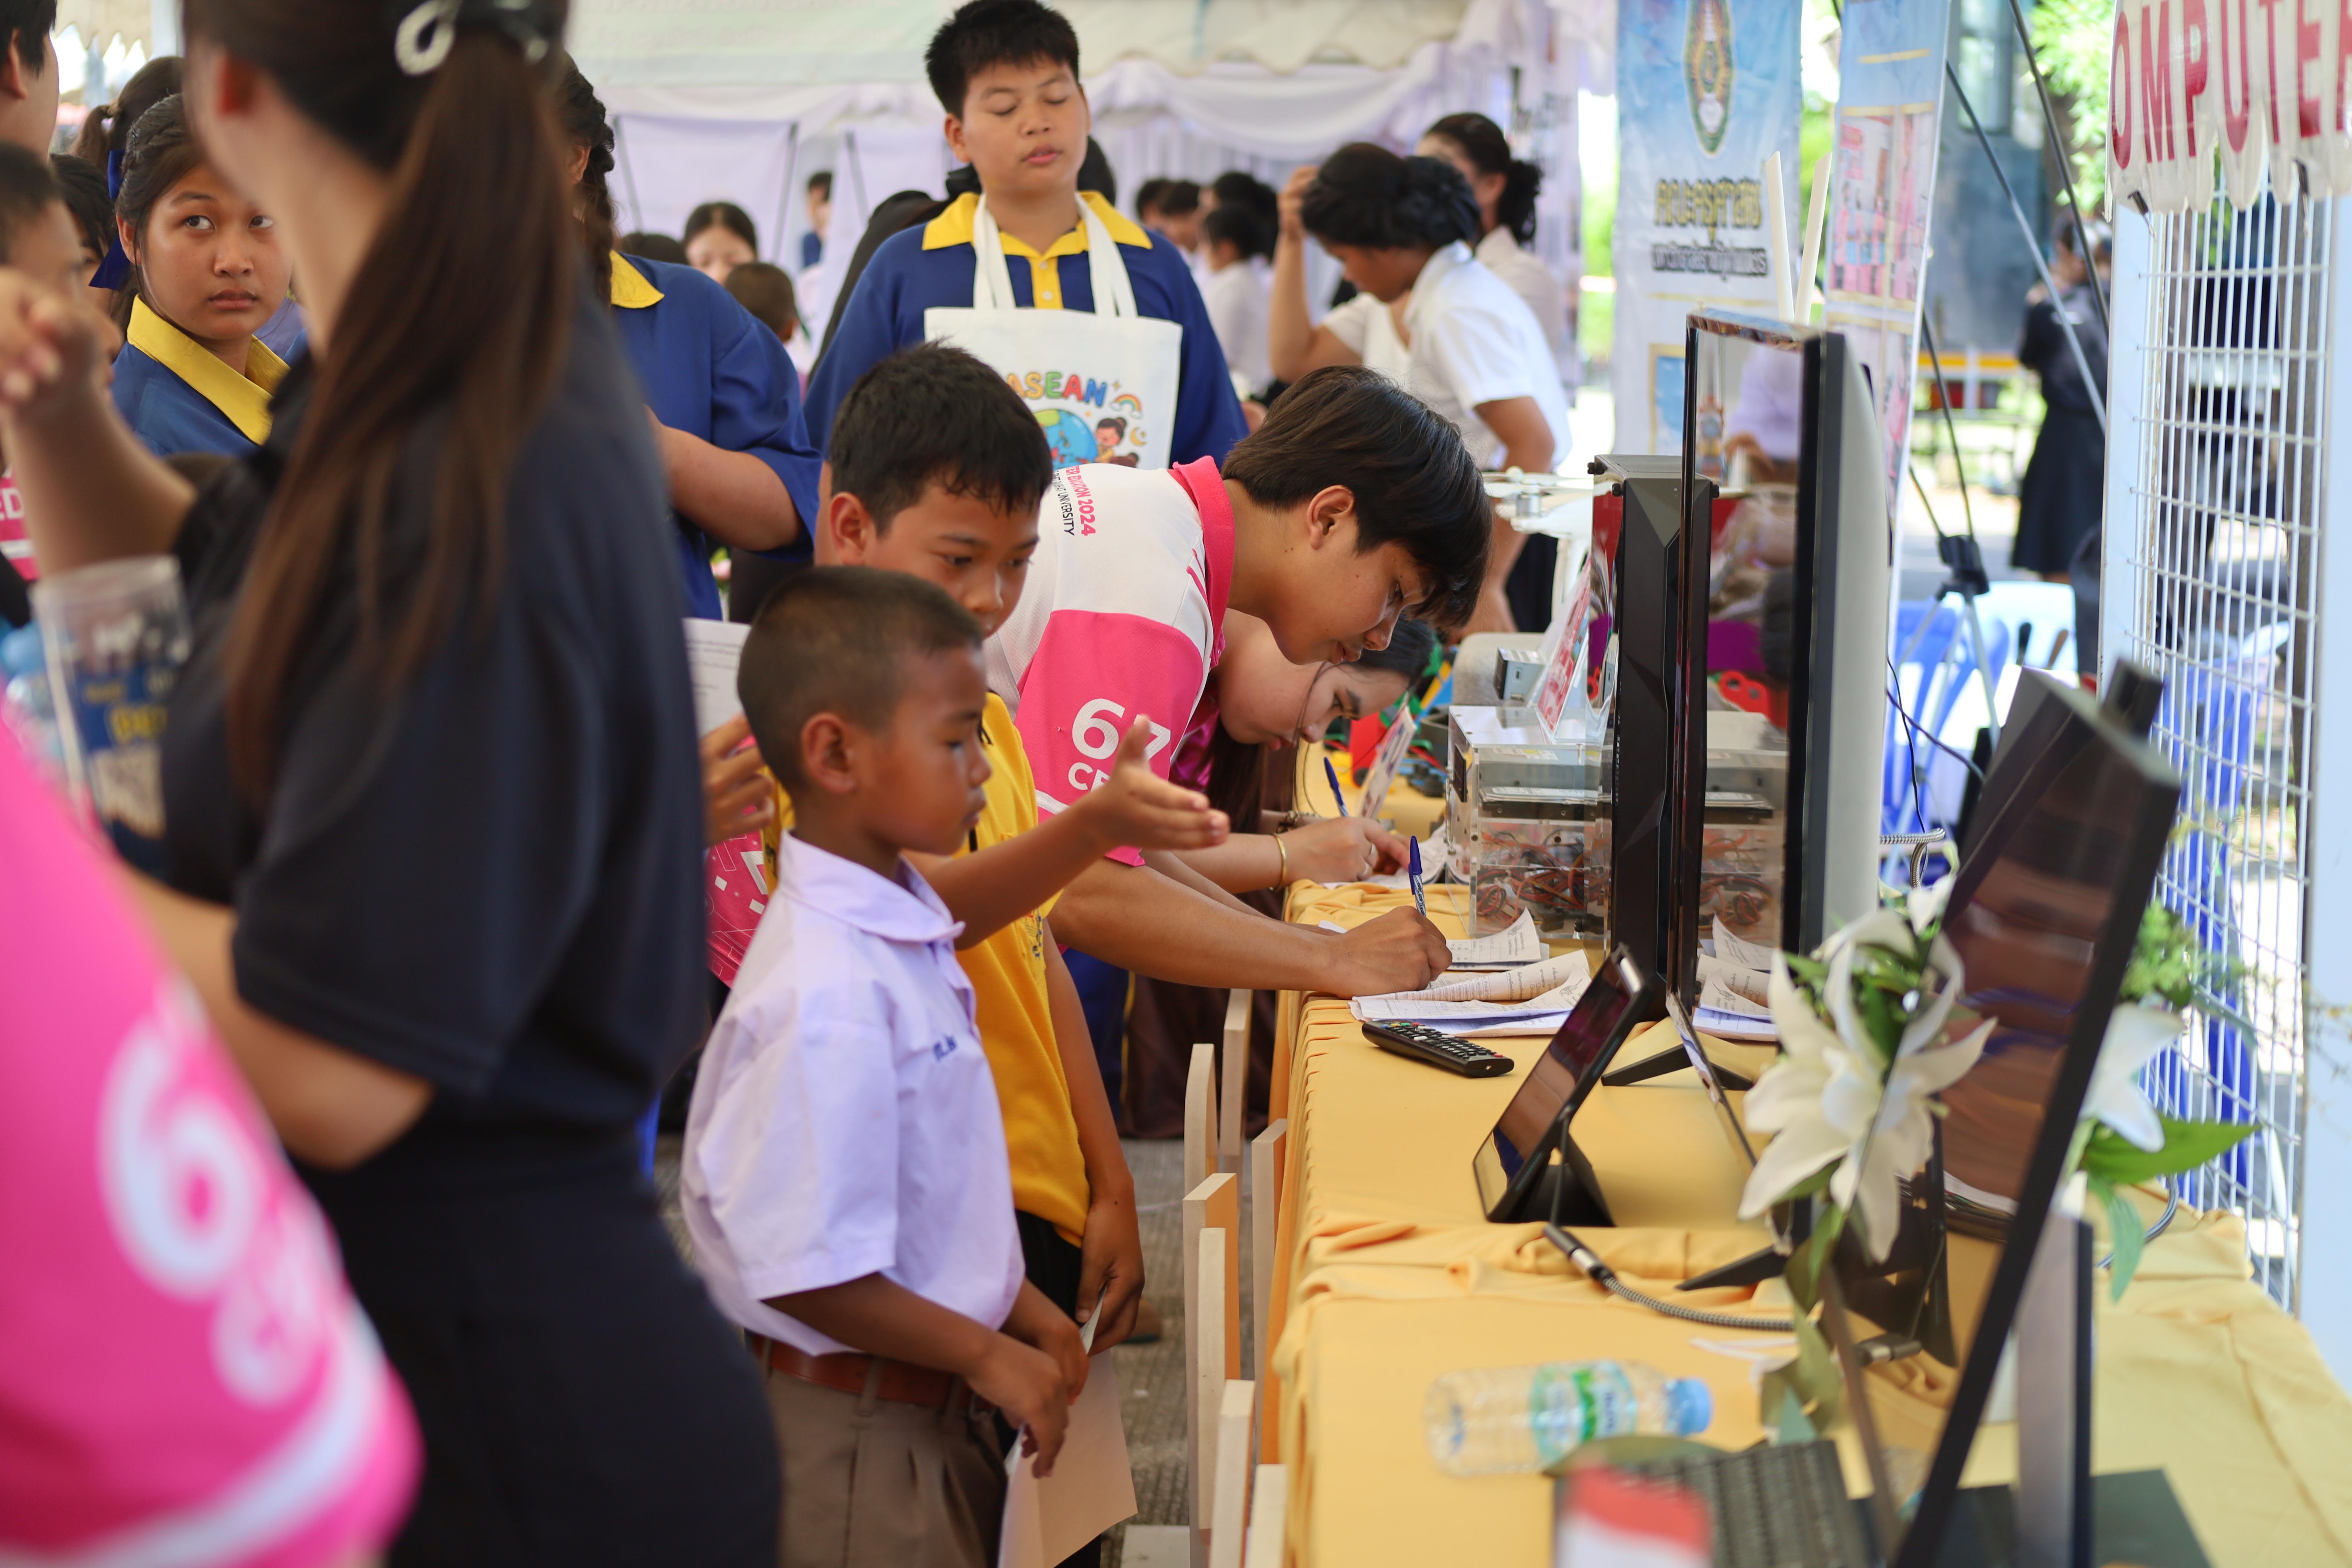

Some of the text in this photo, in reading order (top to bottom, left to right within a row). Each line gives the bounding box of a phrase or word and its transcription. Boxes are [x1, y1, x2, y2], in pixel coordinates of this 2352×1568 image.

[1007, 372, 1107, 407] ASEAN
[1058, 492, 1074, 536] UNIVERSITY
[1078, 499, 1096, 536] 2024
[1072, 698, 1171, 760] 67
